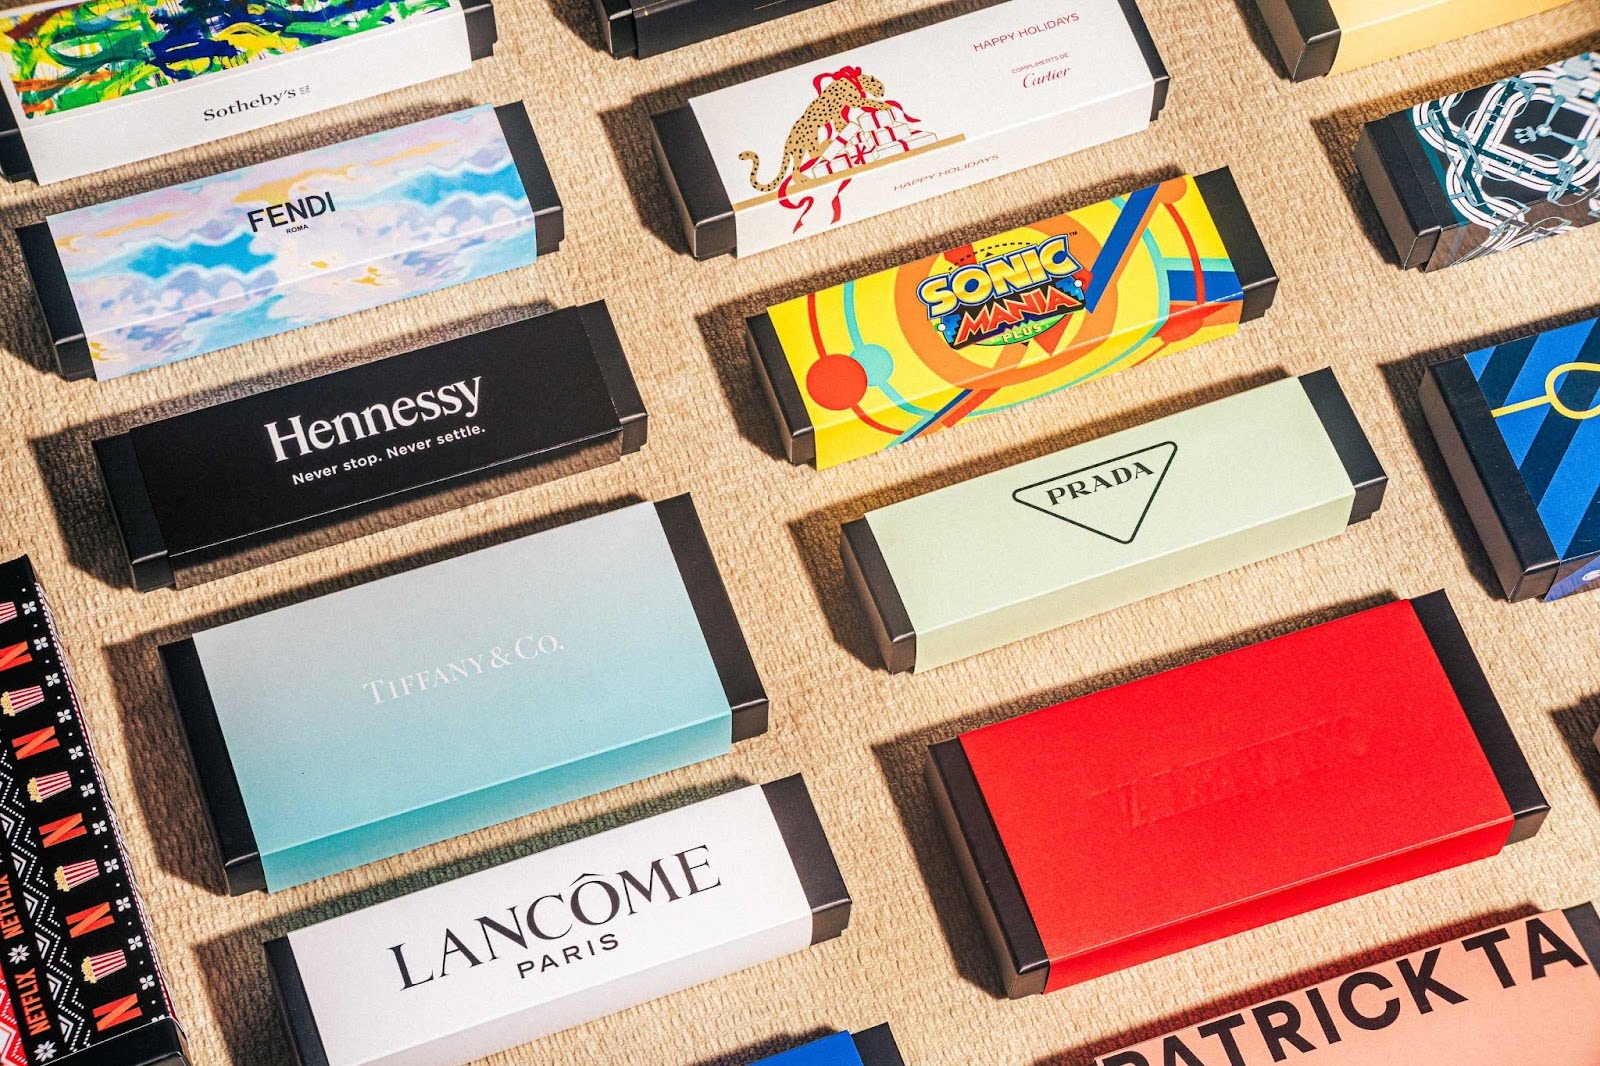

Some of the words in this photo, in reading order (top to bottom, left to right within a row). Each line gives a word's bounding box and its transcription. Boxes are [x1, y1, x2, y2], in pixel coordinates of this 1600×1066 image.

[973, 32, 1016, 52] HAPPY
[1018, 12, 1080, 38] HOLIDAYS
[1011, 55, 1059, 74] COMPLIMENTS
[1059, 52, 1070, 60] DE
[1022, 67, 1071, 89] Cartier
[203, 87, 297, 123] Sotheby's
[893, 172, 938, 192] HAPPY
[938, 153, 1000, 177] HOLIDAYS
[247, 191, 336, 233] FENDI
[286, 223, 309, 235] ROMA
[916, 234, 1084, 320] SONIC
[953, 285, 1083, 347] MANIA
[1002, 322, 1043, 344] PLUS
[264, 375, 482, 463] Hennessy
[292, 464, 339, 486] Never
[343, 453, 384, 472] stop.
[386, 437, 433, 460] Never
[437, 423, 487, 446] settle.
[1046, 461, 1155, 506] PRADA
[490, 646, 513, 669] &
[386, 843, 722, 992] LANCÔME
[517, 933, 619, 979] PARIS
[14, 967, 52, 1037] NETFLIX
[1101, 946, 1470, 1066] TRICK
[1462, 916, 1589, 990] TA
